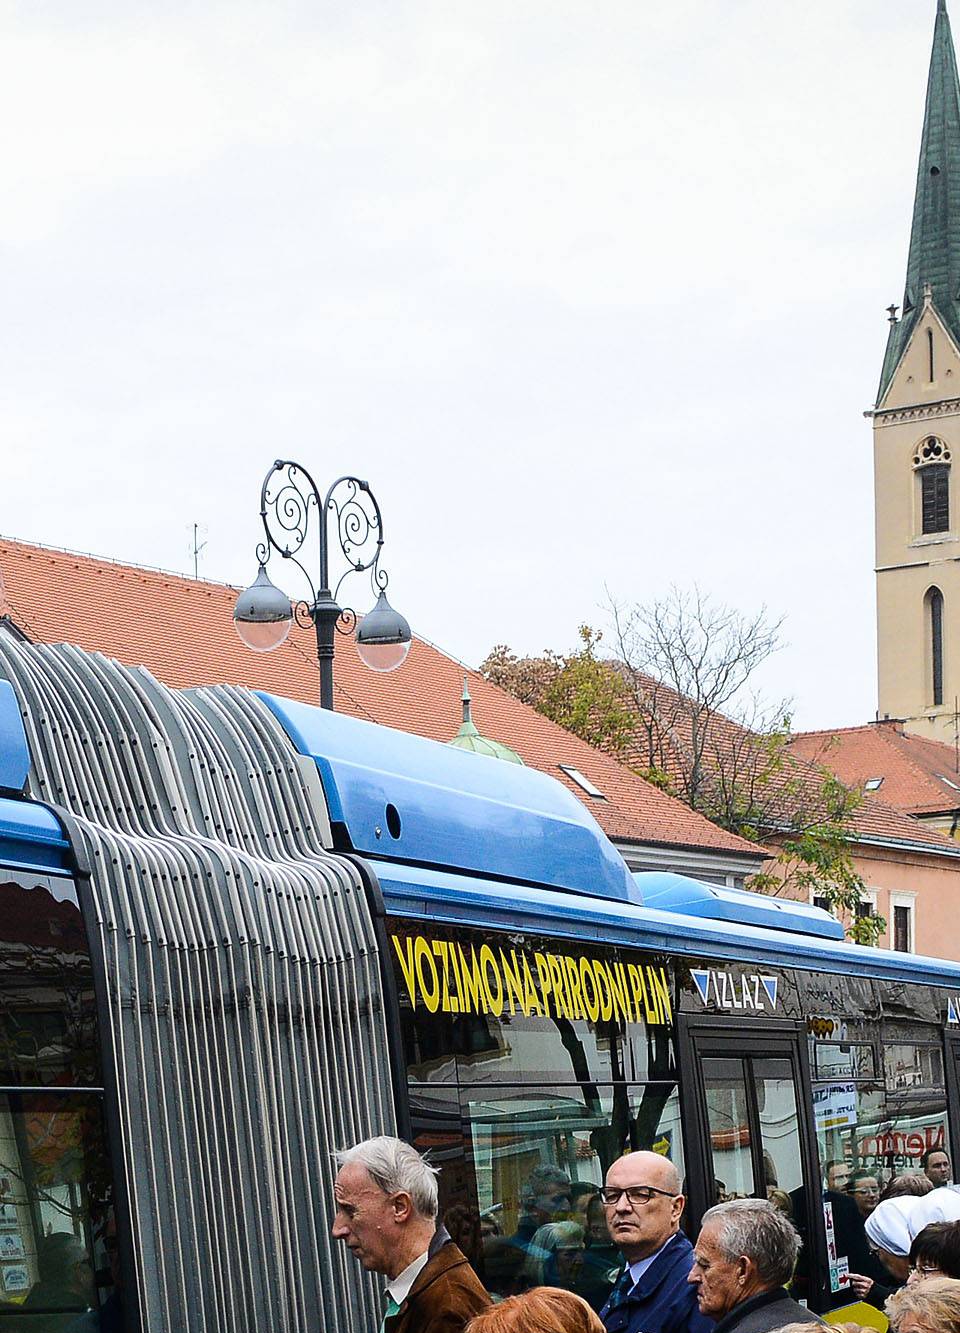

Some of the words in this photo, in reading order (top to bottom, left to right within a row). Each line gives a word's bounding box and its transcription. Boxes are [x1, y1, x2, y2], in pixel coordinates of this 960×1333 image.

[391, 935, 503, 1017] VOZIMO
[499, 946, 543, 1018] NA
[534, 951, 633, 1024] PRIRODNI
[626, 963, 674, 1027] PLIN
[711, 971, 764, 1010] IZLAZ
